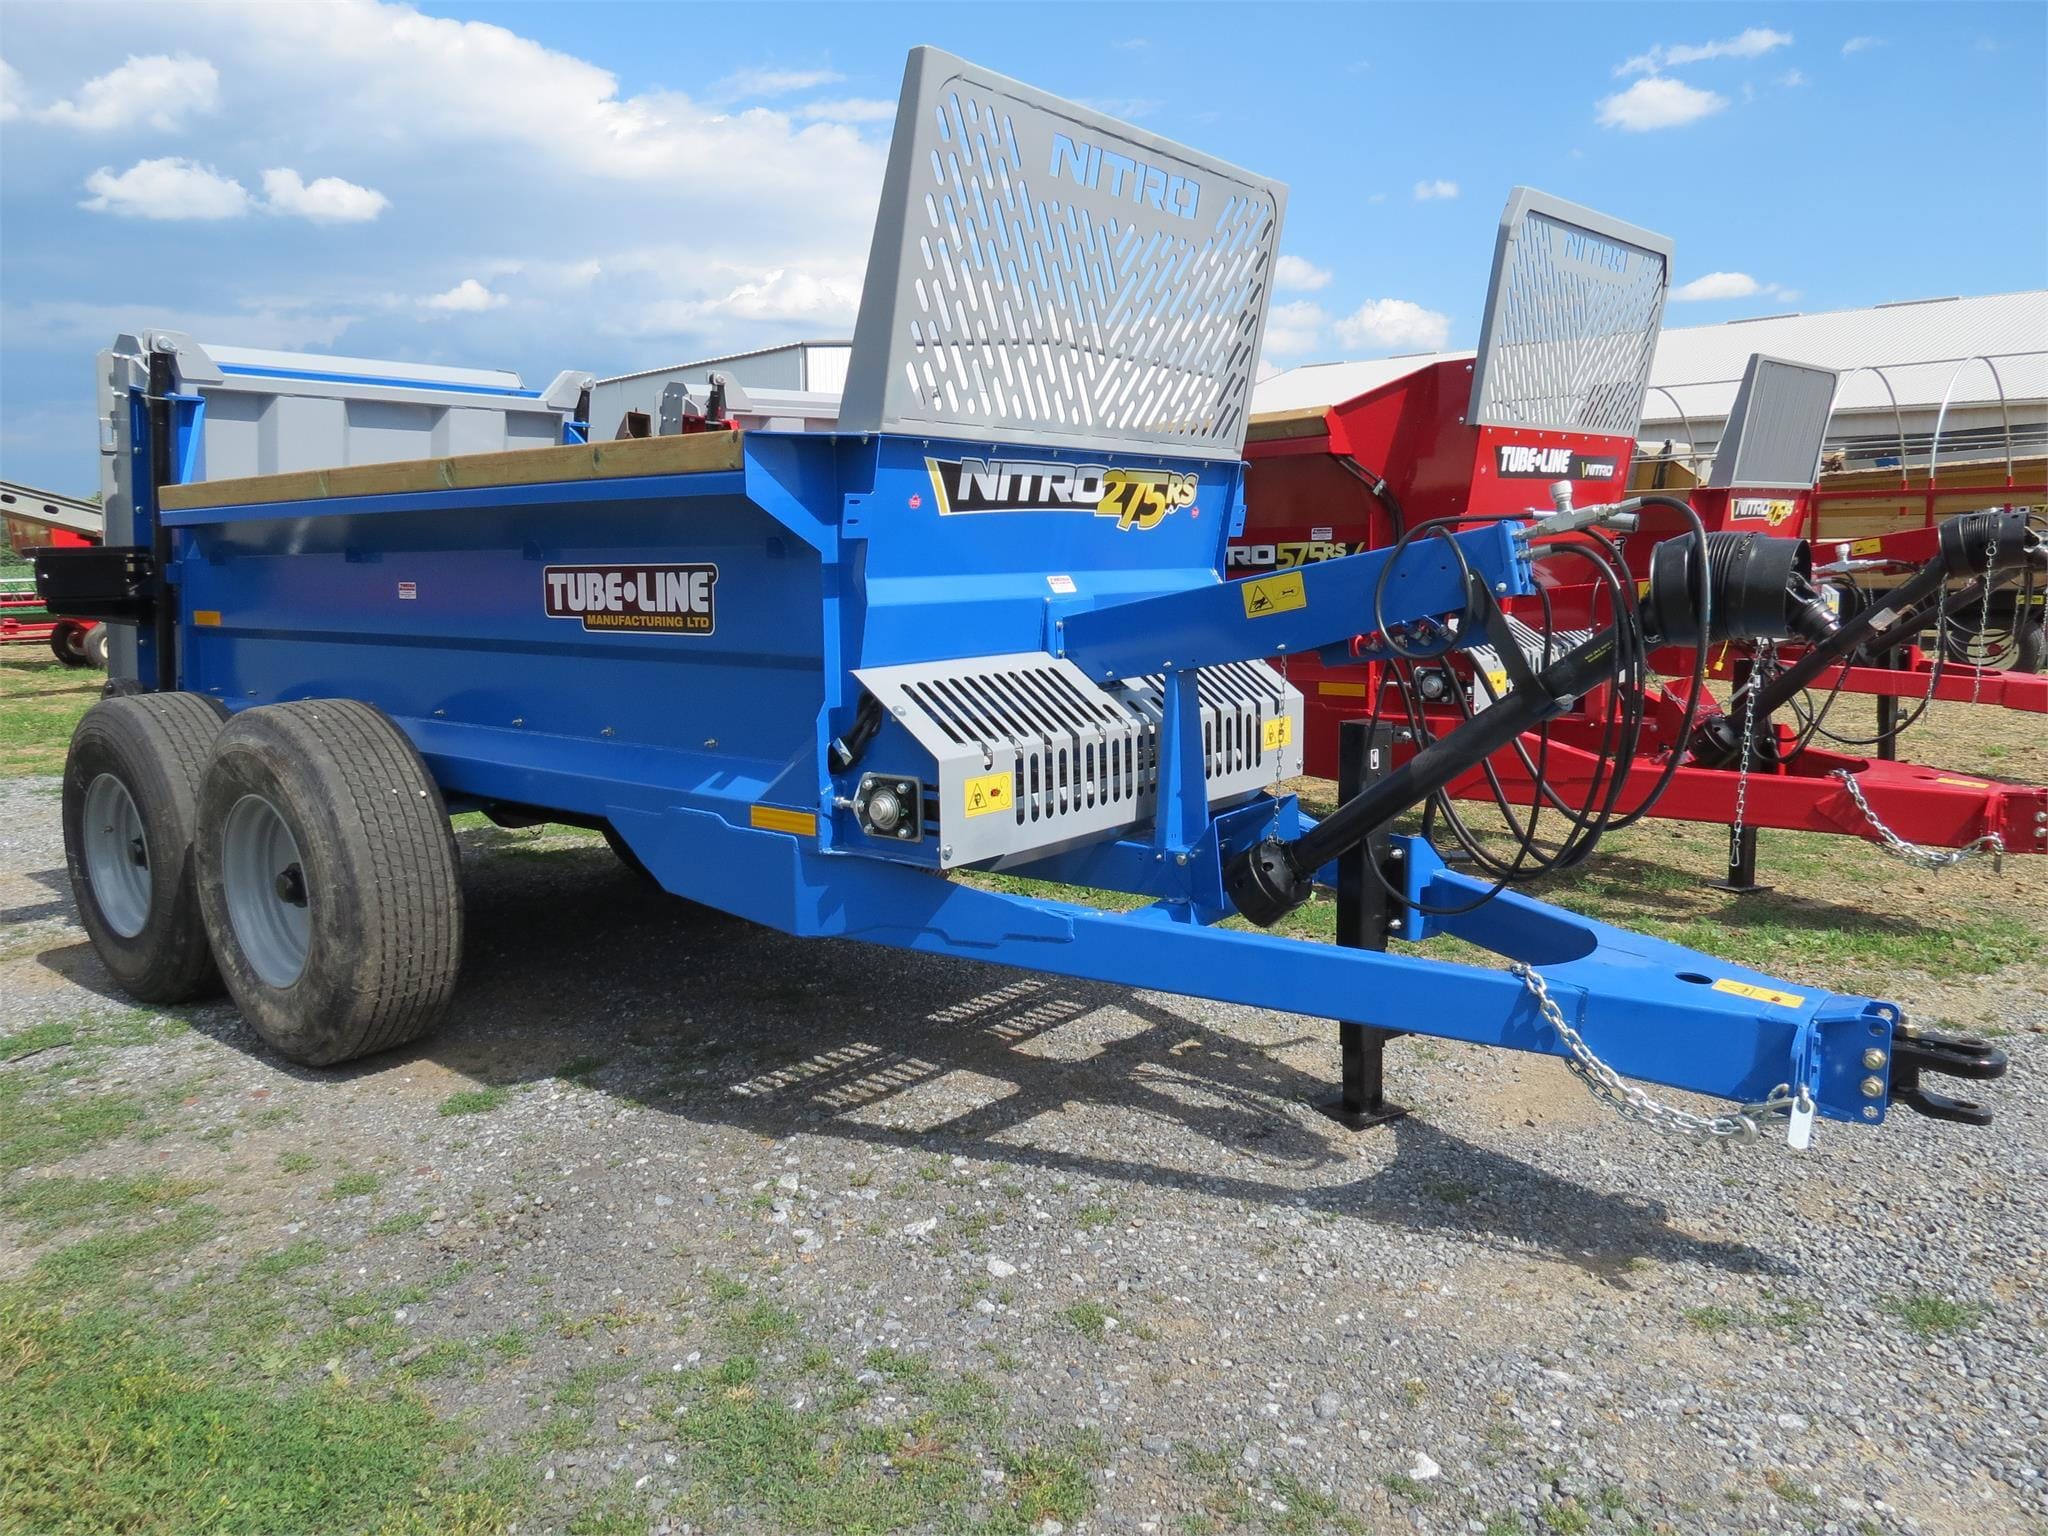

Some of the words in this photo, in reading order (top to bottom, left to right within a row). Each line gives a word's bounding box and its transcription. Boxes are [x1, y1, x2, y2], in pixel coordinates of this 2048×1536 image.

[1050, 132, 1200, 219] NITRO
[1564, 230, 1629, 273] NITRO
[1585, 463, 1613, 477] NITRO
[587, 614, 683, 628] MANUFACTURING
[687, 617, 709, 628] LTD
